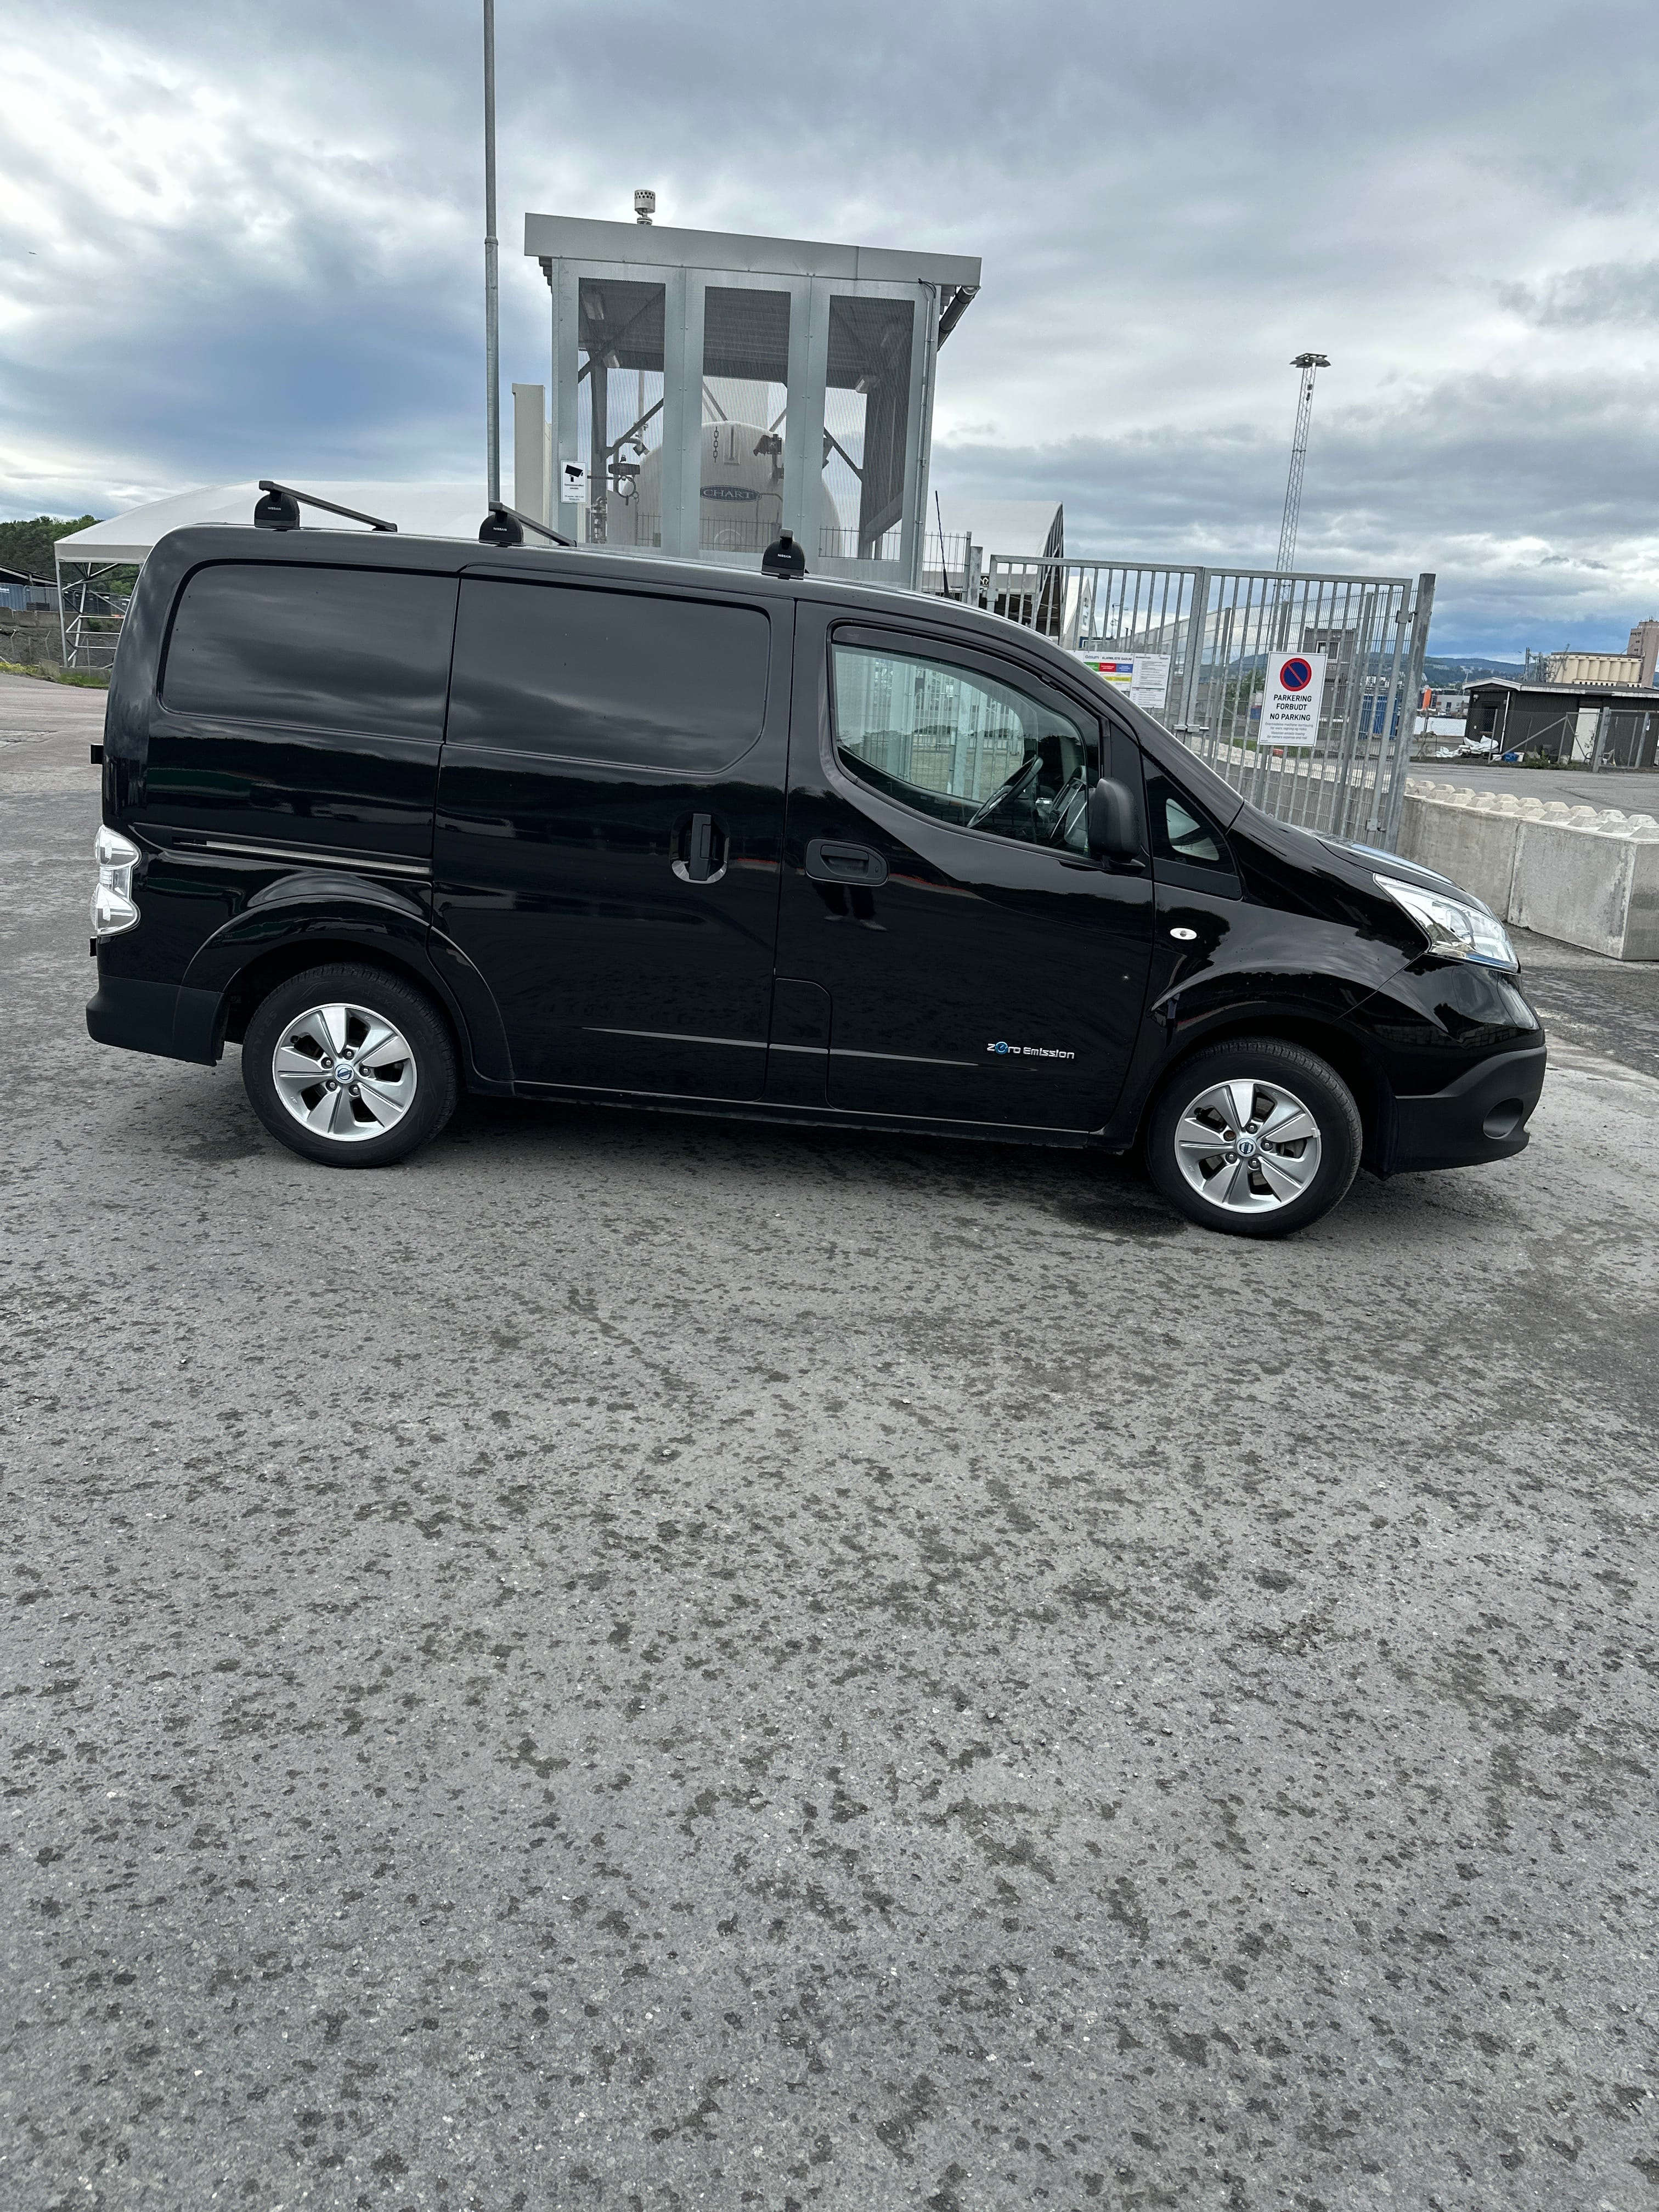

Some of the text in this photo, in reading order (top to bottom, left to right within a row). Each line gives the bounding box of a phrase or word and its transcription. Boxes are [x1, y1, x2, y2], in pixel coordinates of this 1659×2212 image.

[703, 489, 754, 499] CHART
[1273, 694, 1312, 702] PARKERING
[1023, 1047, 1075, 1059] Emission
